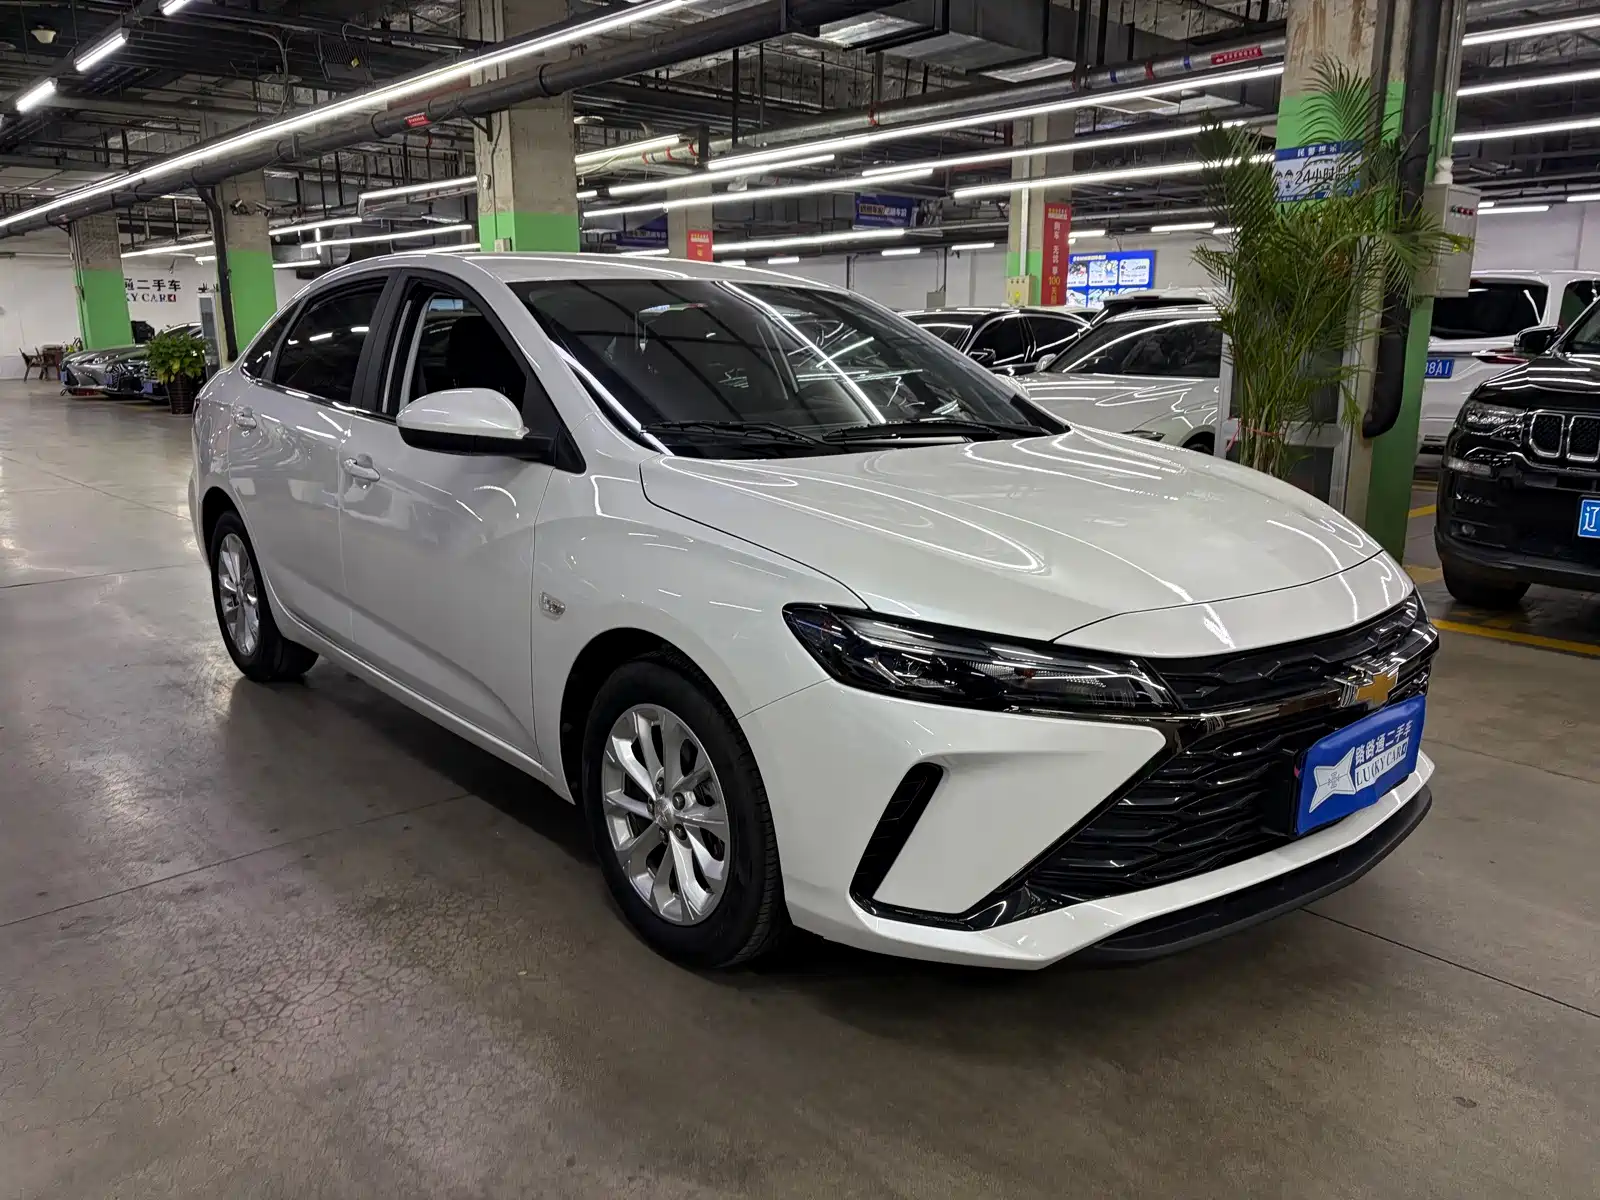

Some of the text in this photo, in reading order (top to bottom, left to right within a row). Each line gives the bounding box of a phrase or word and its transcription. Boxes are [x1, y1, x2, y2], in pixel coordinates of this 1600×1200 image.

[1048, 276, 1061, 286] 100
[141, 293, 167, 302] CAR
[1583, 506, 1600, 532] 辽
[1355, 720, 1414, 766] 路路通二手车
[1356, 743, 1404, 787] LUCKY CAR
